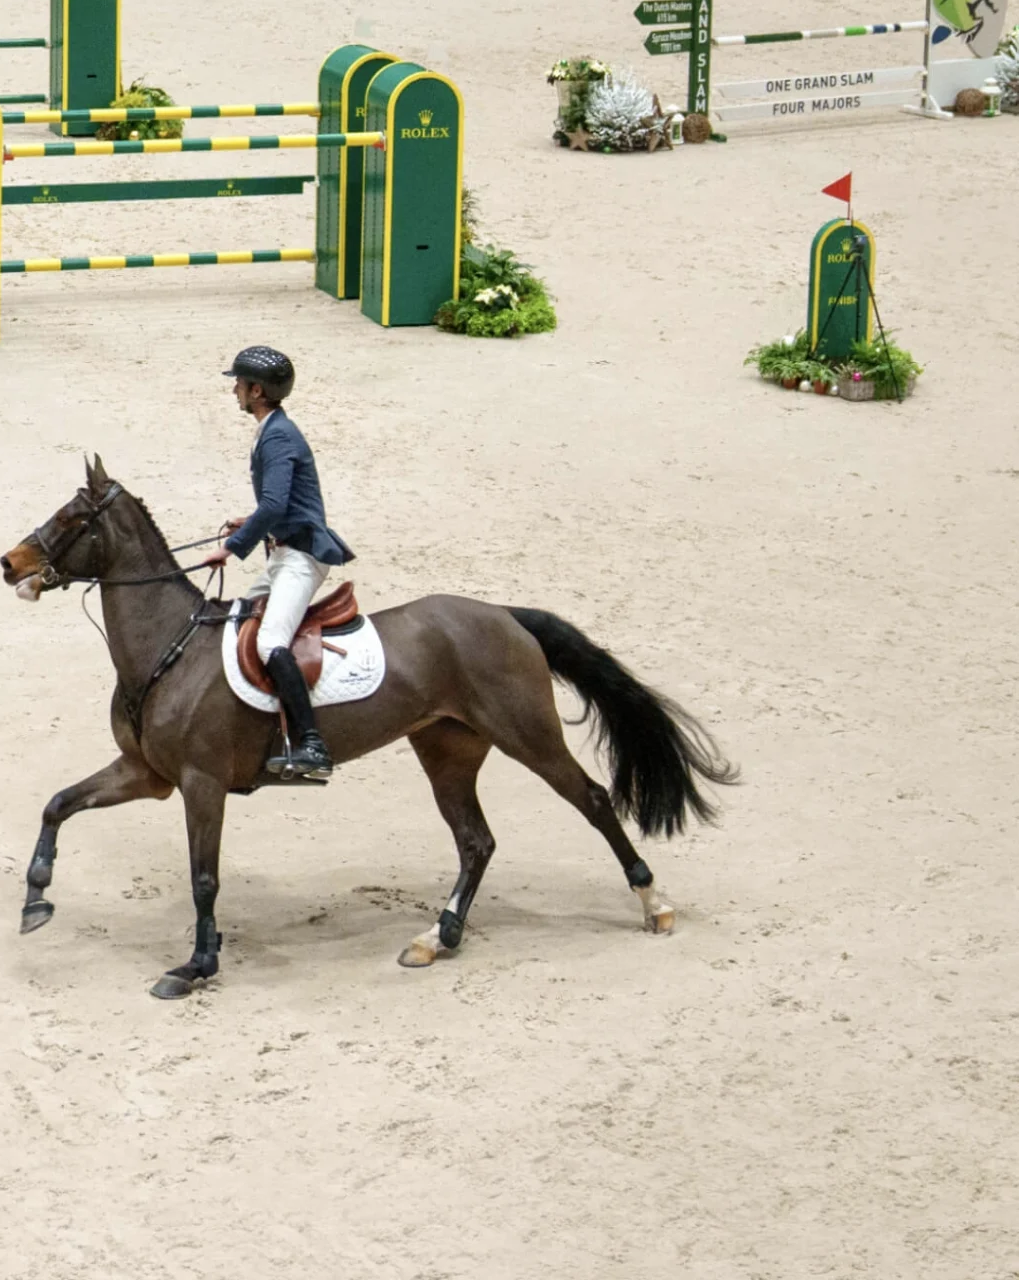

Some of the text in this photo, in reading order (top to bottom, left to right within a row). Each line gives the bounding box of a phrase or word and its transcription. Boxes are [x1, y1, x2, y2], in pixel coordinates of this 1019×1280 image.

[695, 53, 706, 113] SLAM
[766, 72, 874, 93] ONE GRAND SLAM
[772, 96, 861, 116] FOUR MAJORS
[400, 127, 450, 139] ROLEX
[827, 253, 857, 264] ROL
